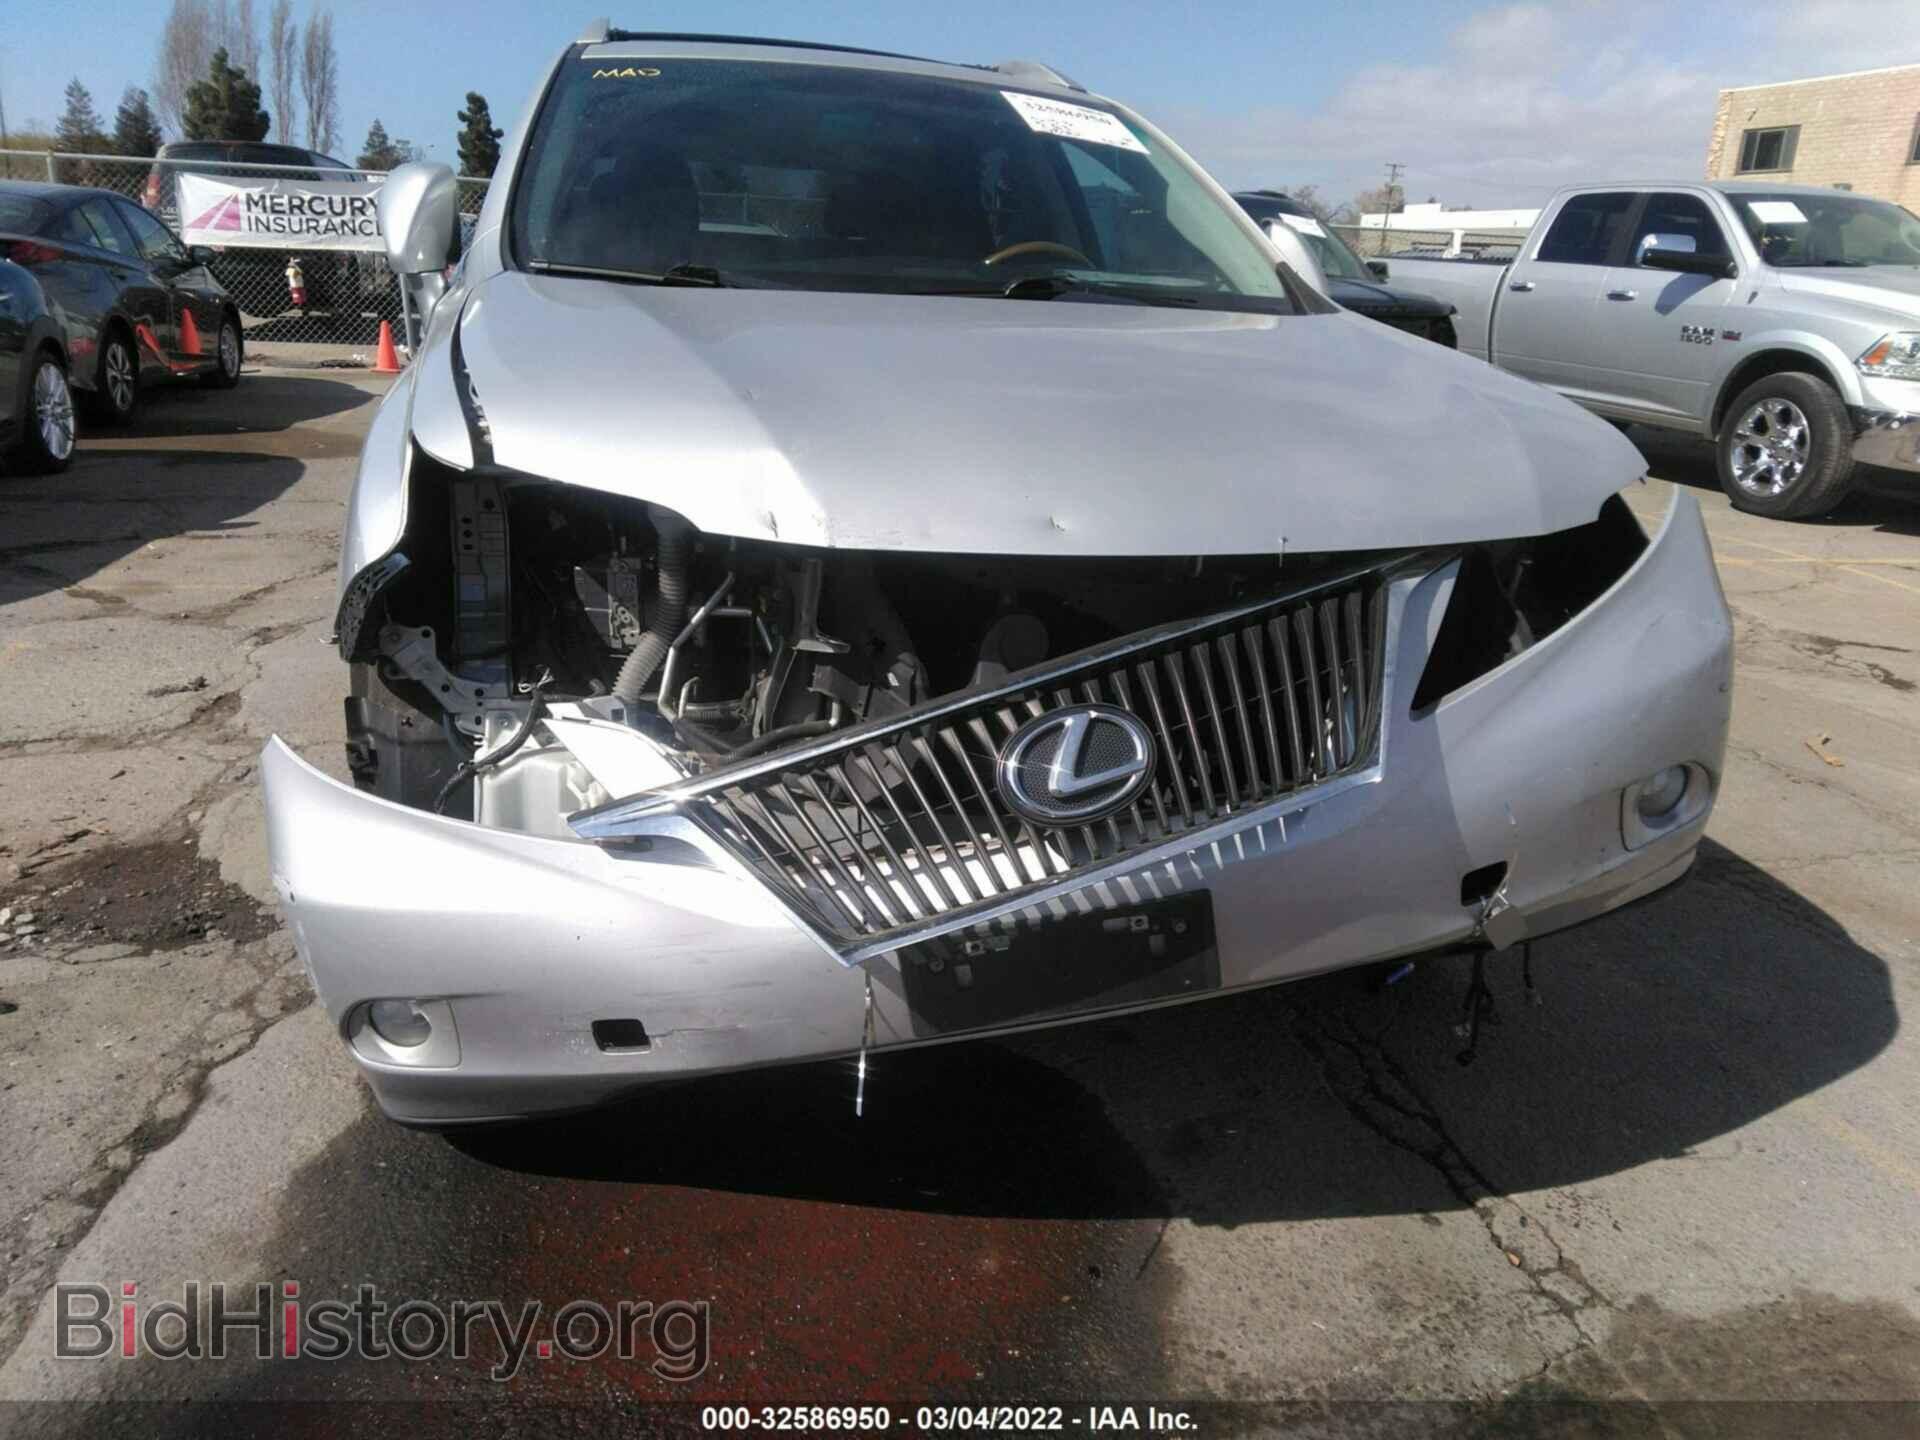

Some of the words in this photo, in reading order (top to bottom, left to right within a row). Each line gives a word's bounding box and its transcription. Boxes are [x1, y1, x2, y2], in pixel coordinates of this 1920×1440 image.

[246, 192, 378, 217] MERCURY
[1682, 326, 1715, 336] RAM
[1680, 334, 1713, 345] 1500
